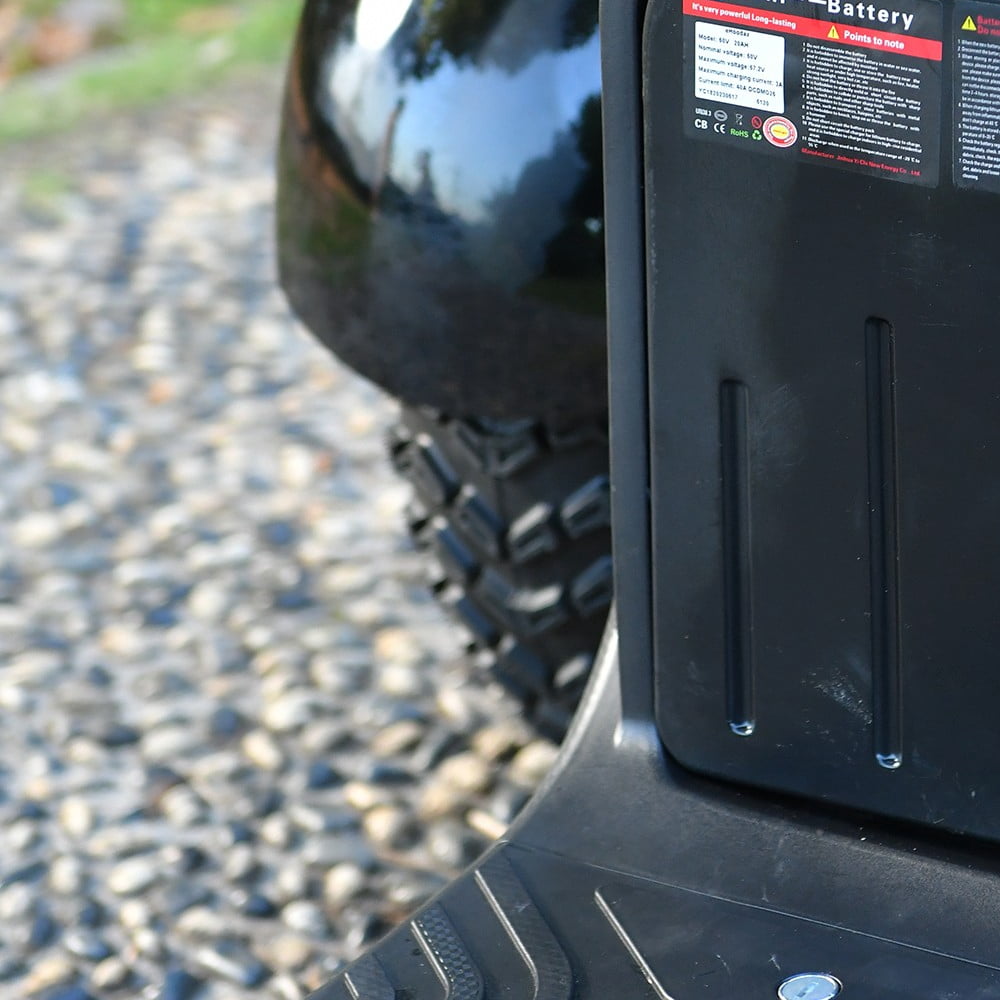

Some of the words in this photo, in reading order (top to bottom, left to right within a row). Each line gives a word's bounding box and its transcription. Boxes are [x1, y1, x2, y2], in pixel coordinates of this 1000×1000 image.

[692, 2, 703, 11] It's
[704, 6, 719, 16] very
[720, 7, 750, 22] powerful
[751, 13, 796, 30] Long-lasting
[977, 26, 989, 35] Do
[844, 31, 871, 44] Points
[873, 37, 882, 46] to
[884, 40, 905, 51] note
[695, 118, 708, 130] CB
[730, 128, 749, 138] RoHS
